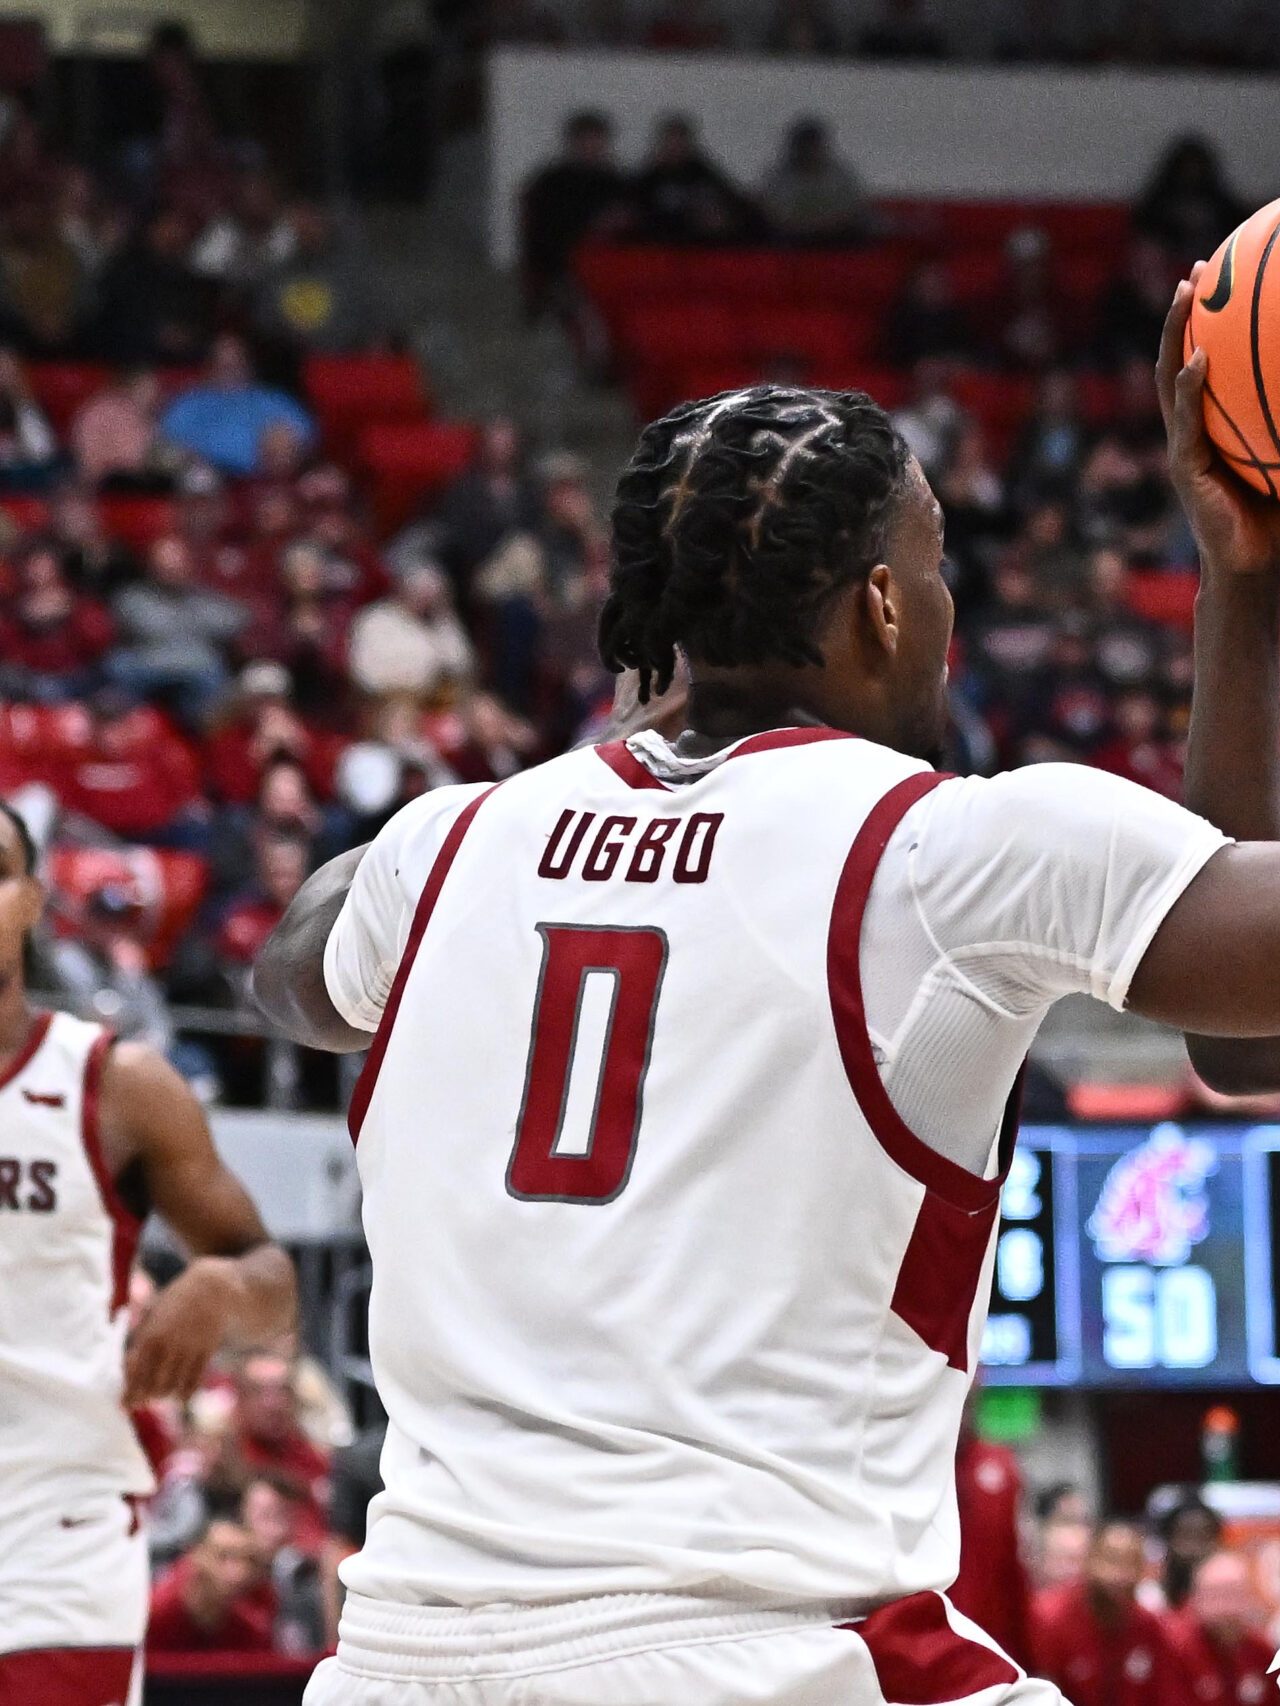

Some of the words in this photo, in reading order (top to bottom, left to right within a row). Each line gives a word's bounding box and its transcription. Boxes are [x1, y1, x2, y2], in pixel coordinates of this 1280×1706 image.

[537, 809, 724, 884] UGBO
[505, 922, 669, 1206] 0
[1102, 1265, 1217, 1368] 50
